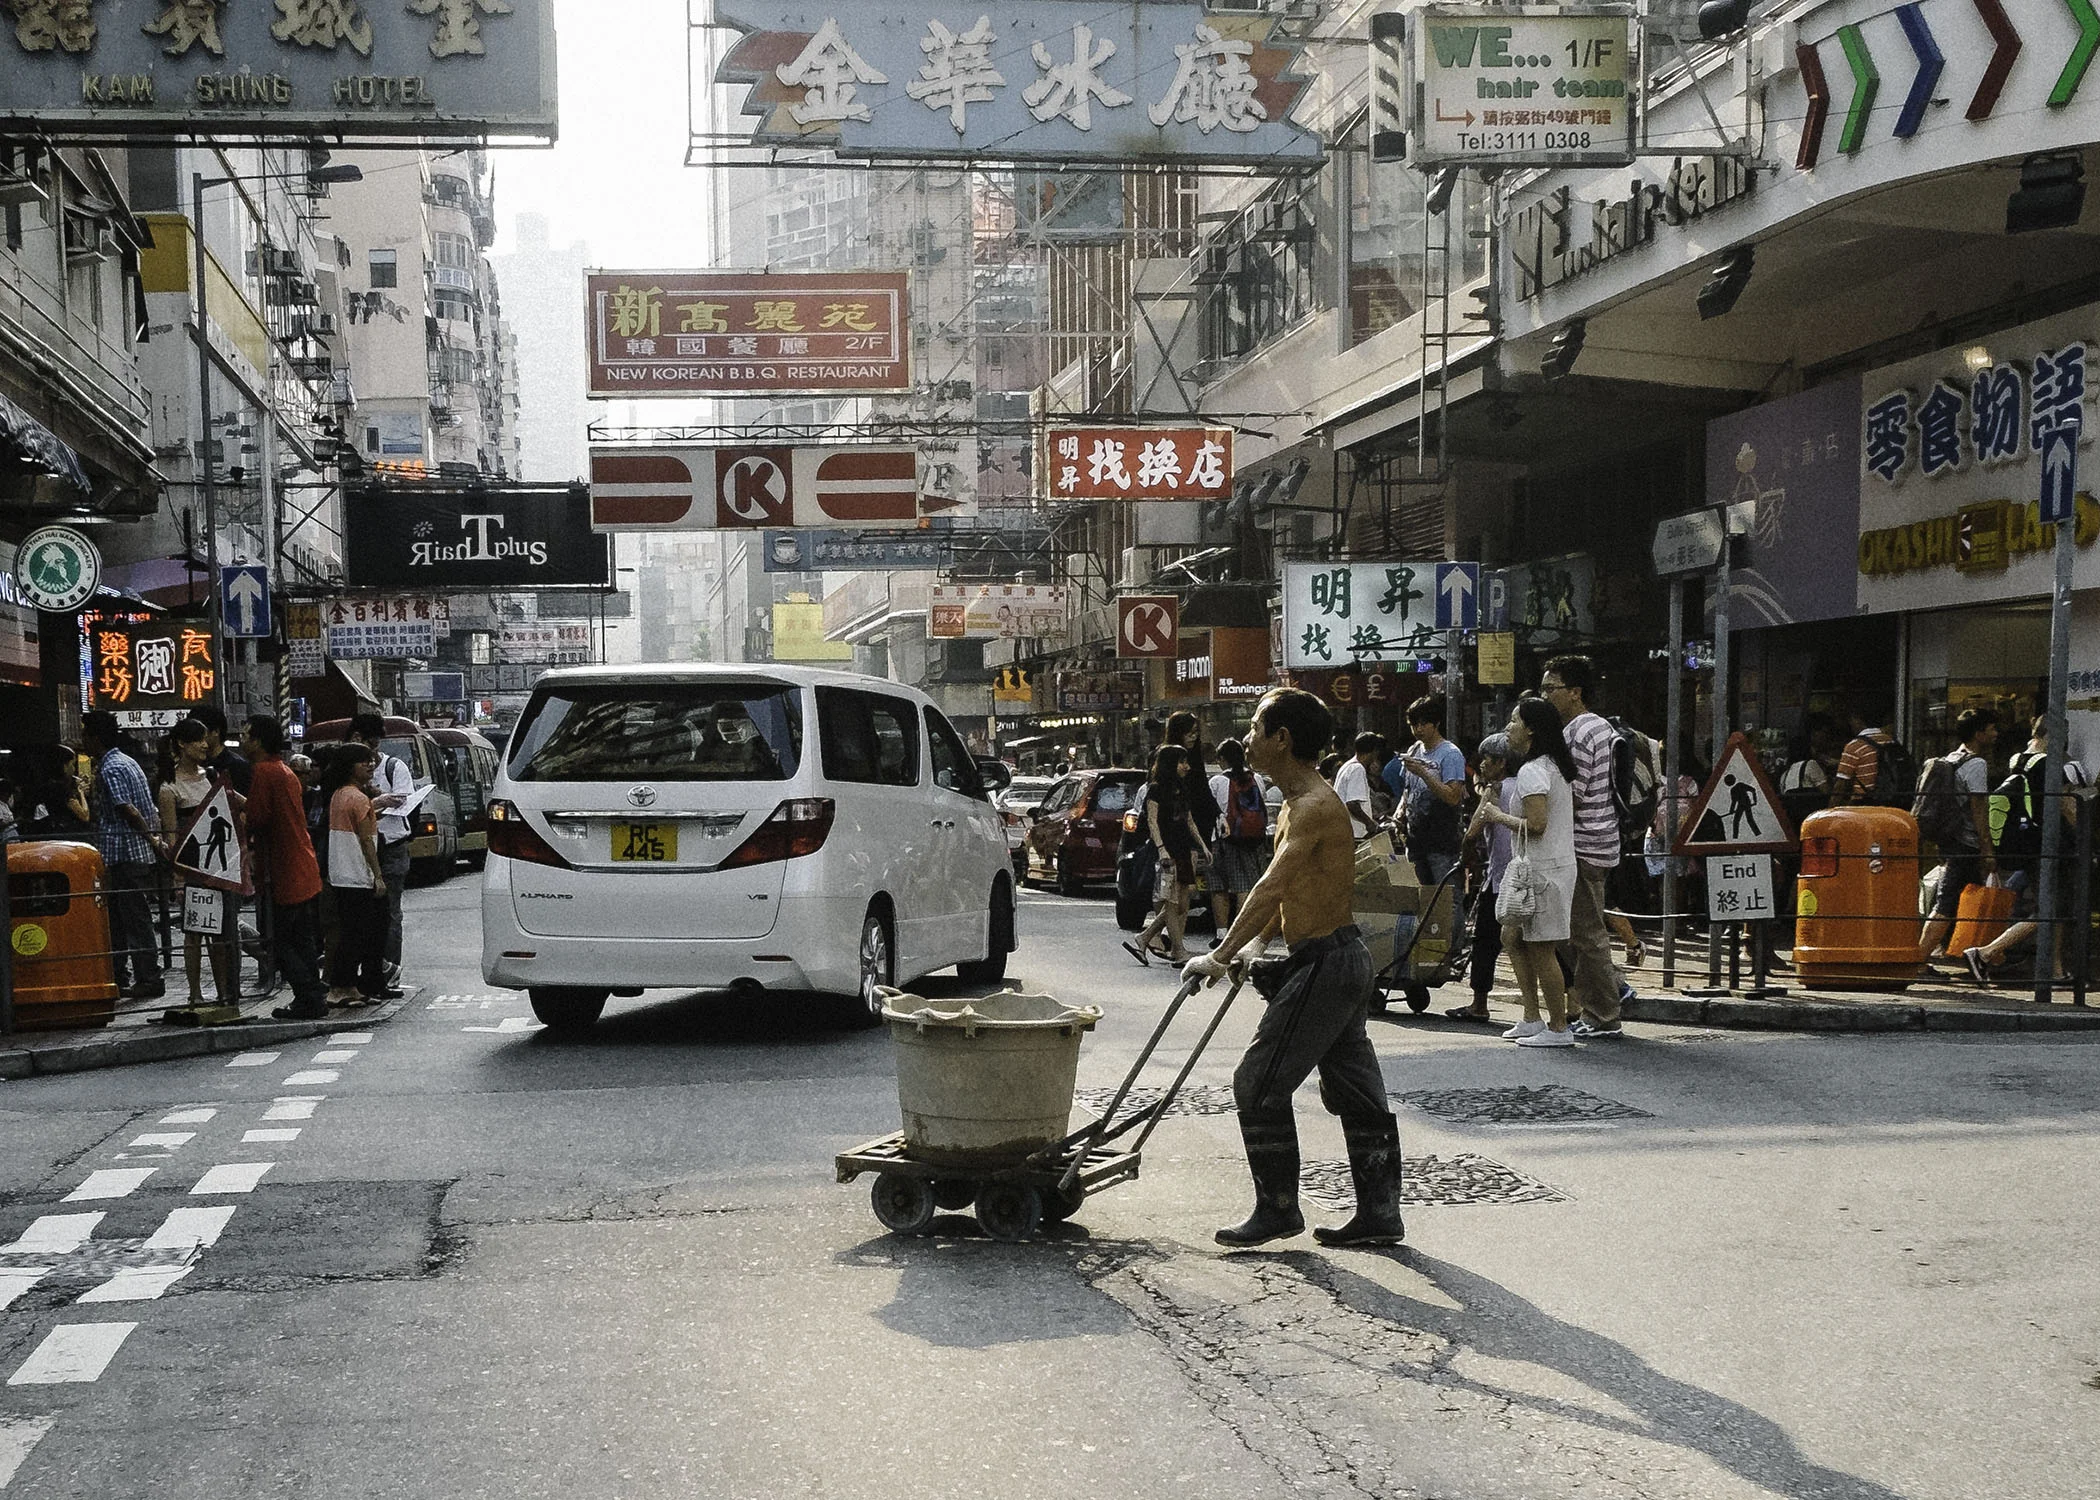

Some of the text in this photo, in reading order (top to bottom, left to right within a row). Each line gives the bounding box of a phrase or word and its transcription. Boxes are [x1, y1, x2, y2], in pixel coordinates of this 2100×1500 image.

[1565, 39, 1615, 68] 1/F
[775, 15, 1268, 134] 金華冰廳
[82, 72, 435, 104] KAM SHING HOTEL
[1477, 77, 1625, 98] hair team
[1458, 132, 1591, 149] Tel:3111 0308
[626, 337, 810, 355] 韓國餐廳
[845, 336, 884, 350] 2/F
[607, 368, 647, 381] NEW
[652, 367, 723, 381] KOREAN
[788, 366, 890, 379] RESTAURANT
[1059, 436, 1080, 492] 明昇
[1087, 438, 1226, 490] 找換店
[1311, 567, 1424, 620] 明昇
[329, 600, 431, 625] 金百利賓館
[1218, 683, 1267, 696] mannings
[630, 824, 658, 843] RC
[622, 843, 665, 861] 445
[1722, 863, 1757, 879] End
[192, 892, 214, 905] End
[520, 892, 573, 900] ALPHARD
[1716, 888, 1768, 913] 終止
